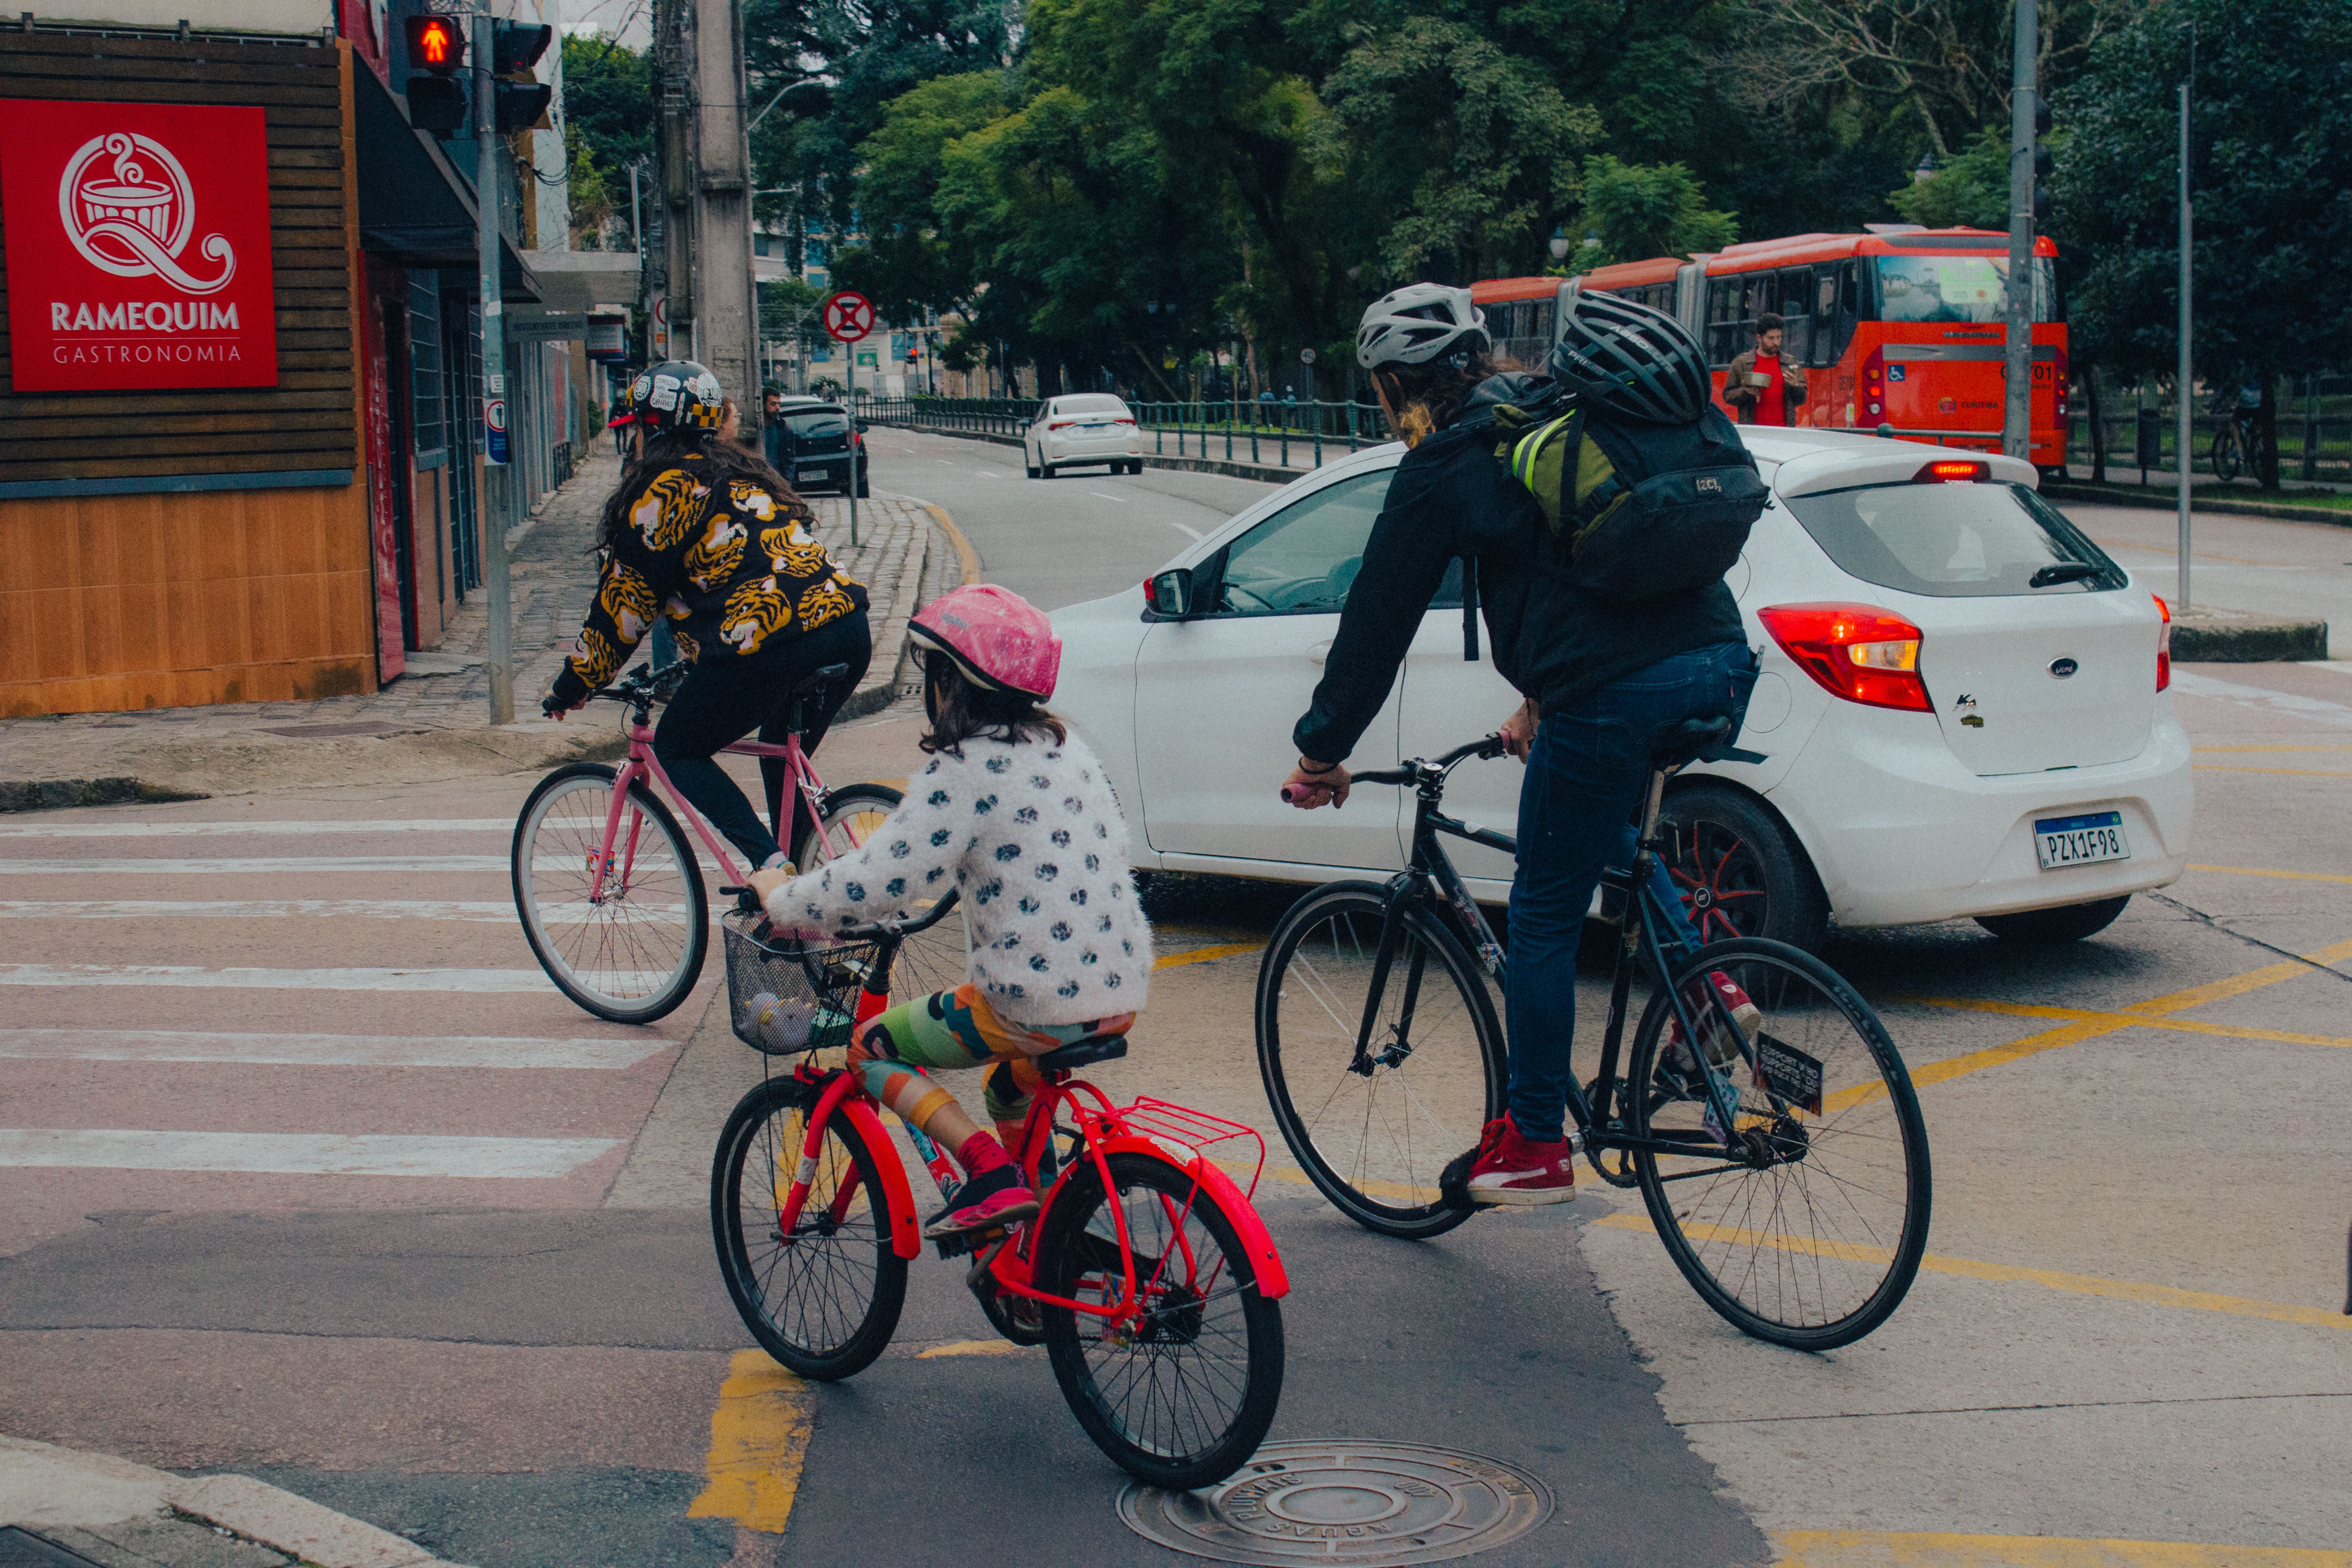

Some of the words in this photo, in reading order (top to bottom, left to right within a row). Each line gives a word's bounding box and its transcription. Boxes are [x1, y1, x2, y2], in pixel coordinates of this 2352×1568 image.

[51, 302, 240, 332] RAMEQUIM
[54, 345, 241, 363] GASTRONOMIA
[1568, 350, 1604, 376] PRIME
[652, 397, 673, 407] CHANGES
[2047, 829, 2119, 862] PZX1F98
[1230, 1473, 1303, 1521] PLUVIAIS
